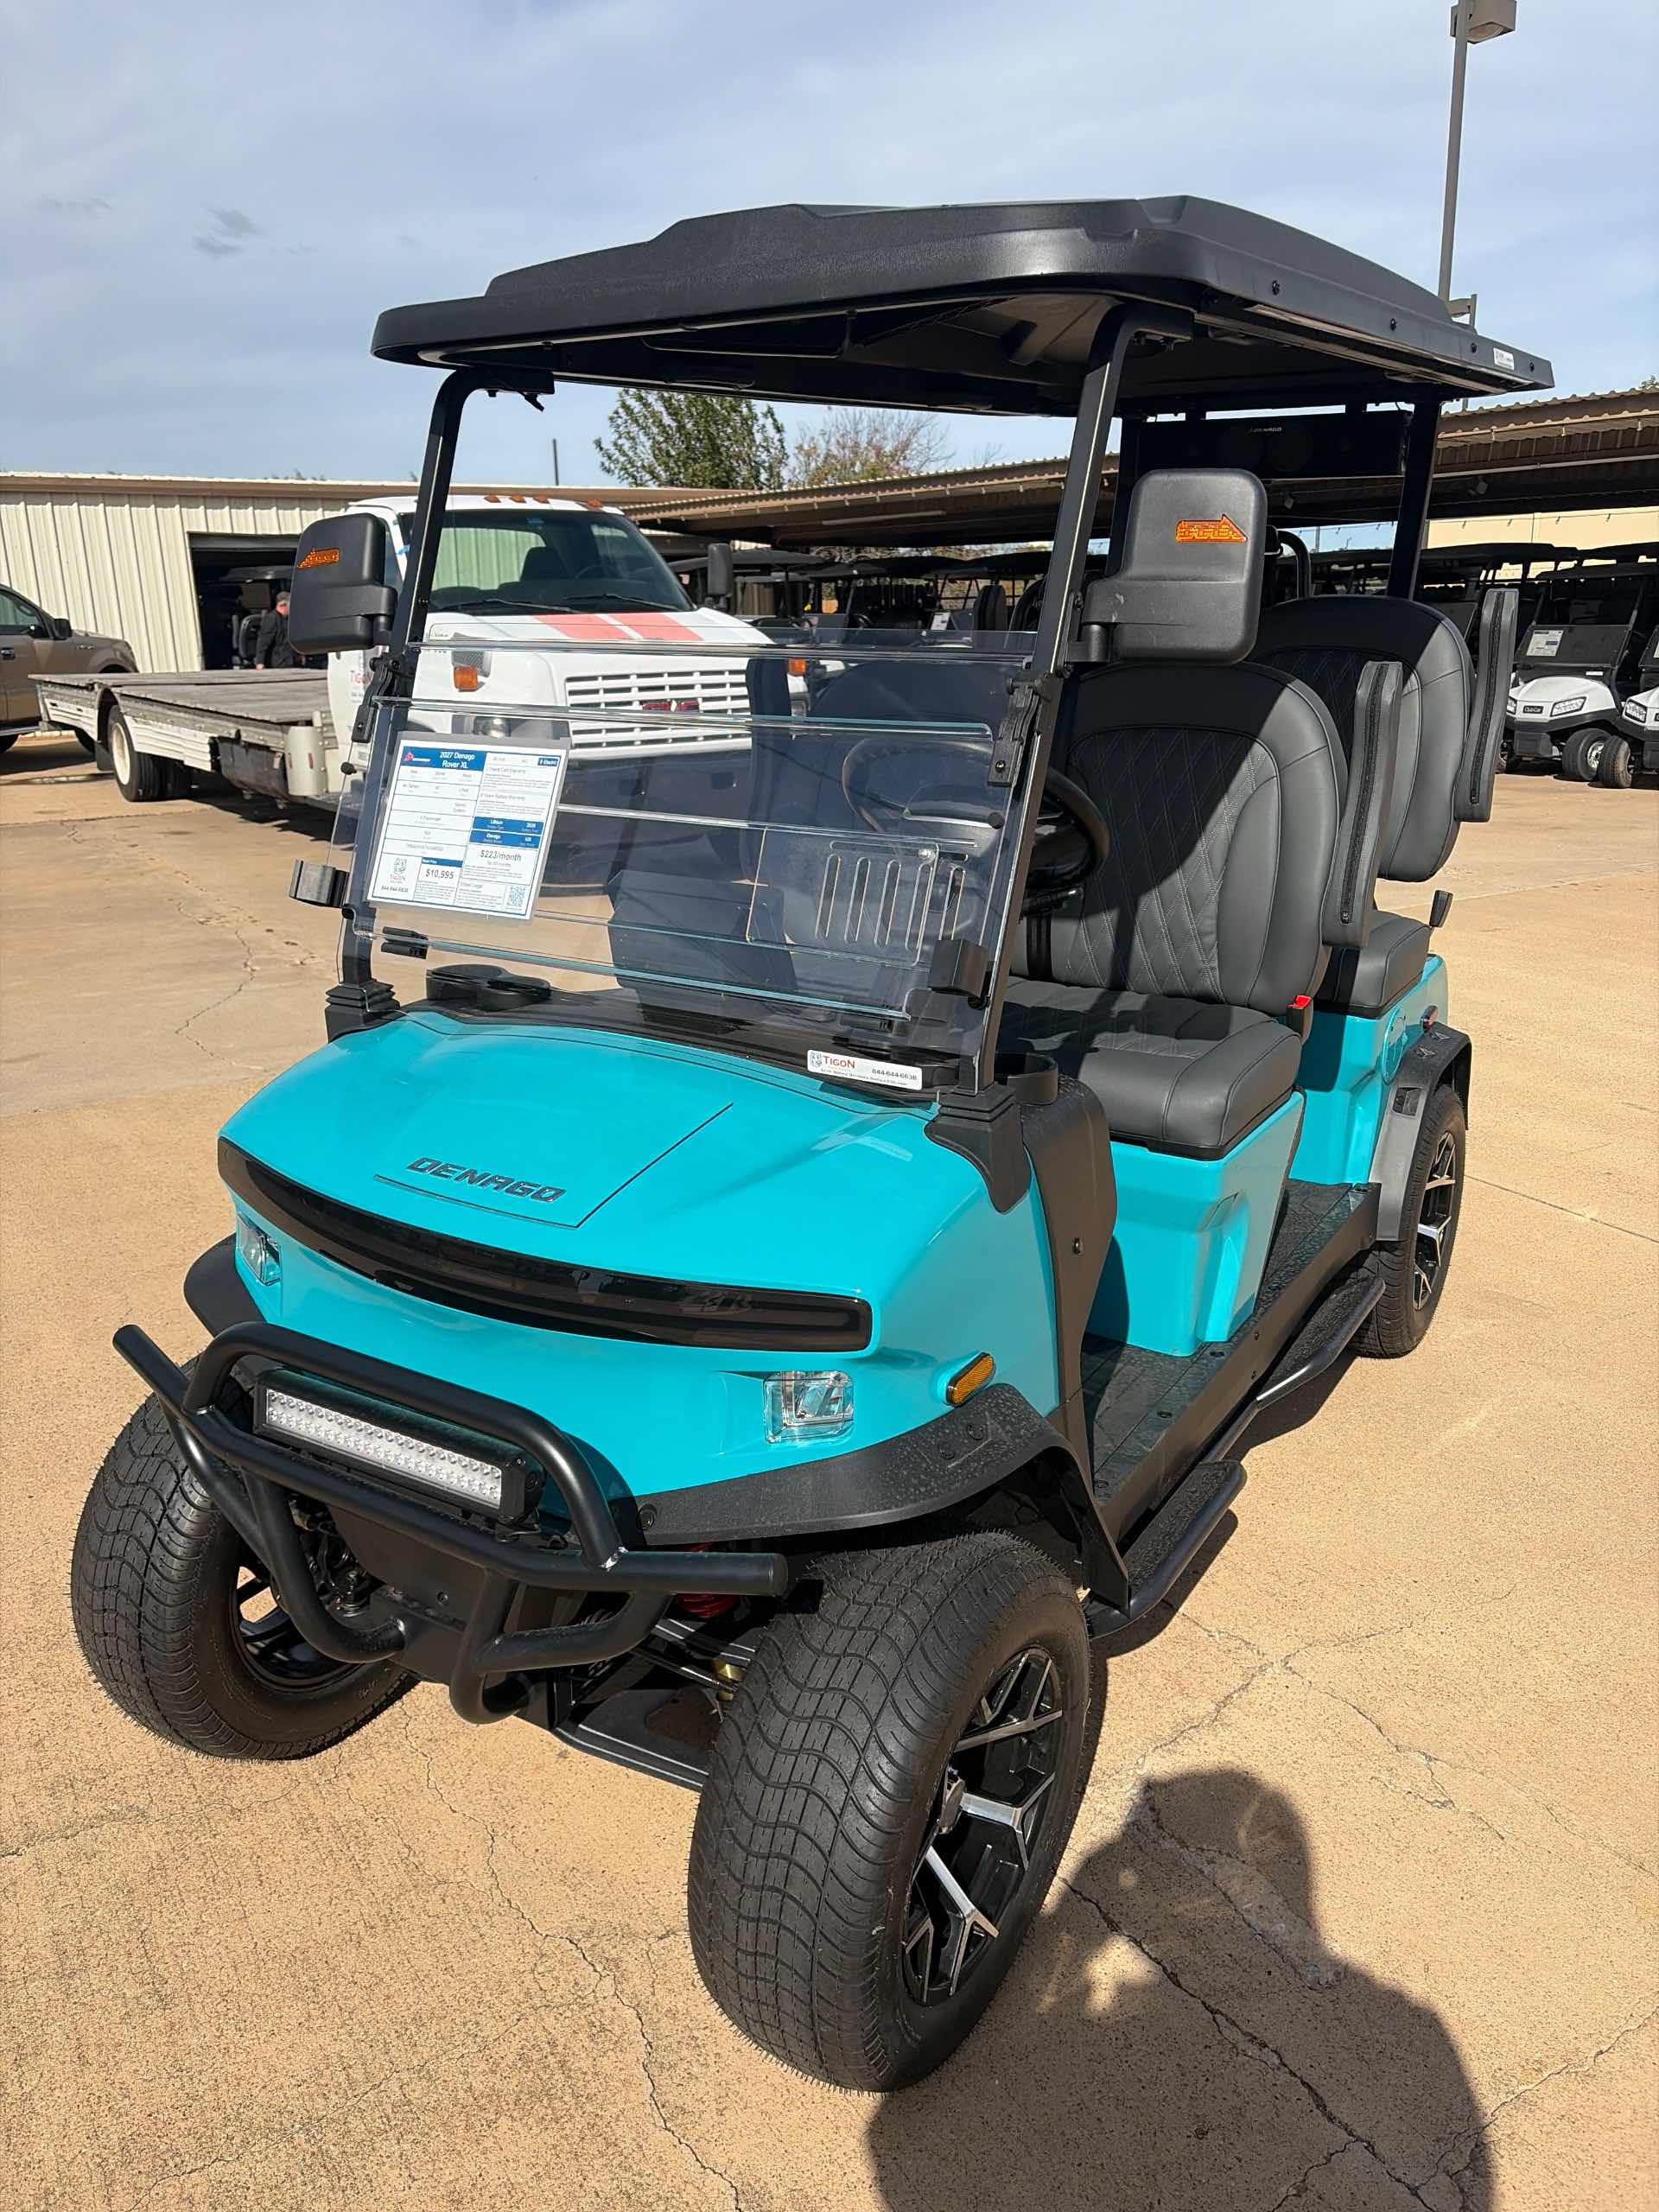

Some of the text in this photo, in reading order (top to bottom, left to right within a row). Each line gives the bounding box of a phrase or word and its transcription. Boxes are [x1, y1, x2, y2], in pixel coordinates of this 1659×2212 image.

[454, 753, 475, 761] Denago
[442, 760, 469, 769] Rover XL
[480, 849, 522, 862] $223/month
[425, 868, 454, 880] $10,995
[823, 1055, 855, 1069] TIGON
[405, 1156, 567, 1204] DENAGO
